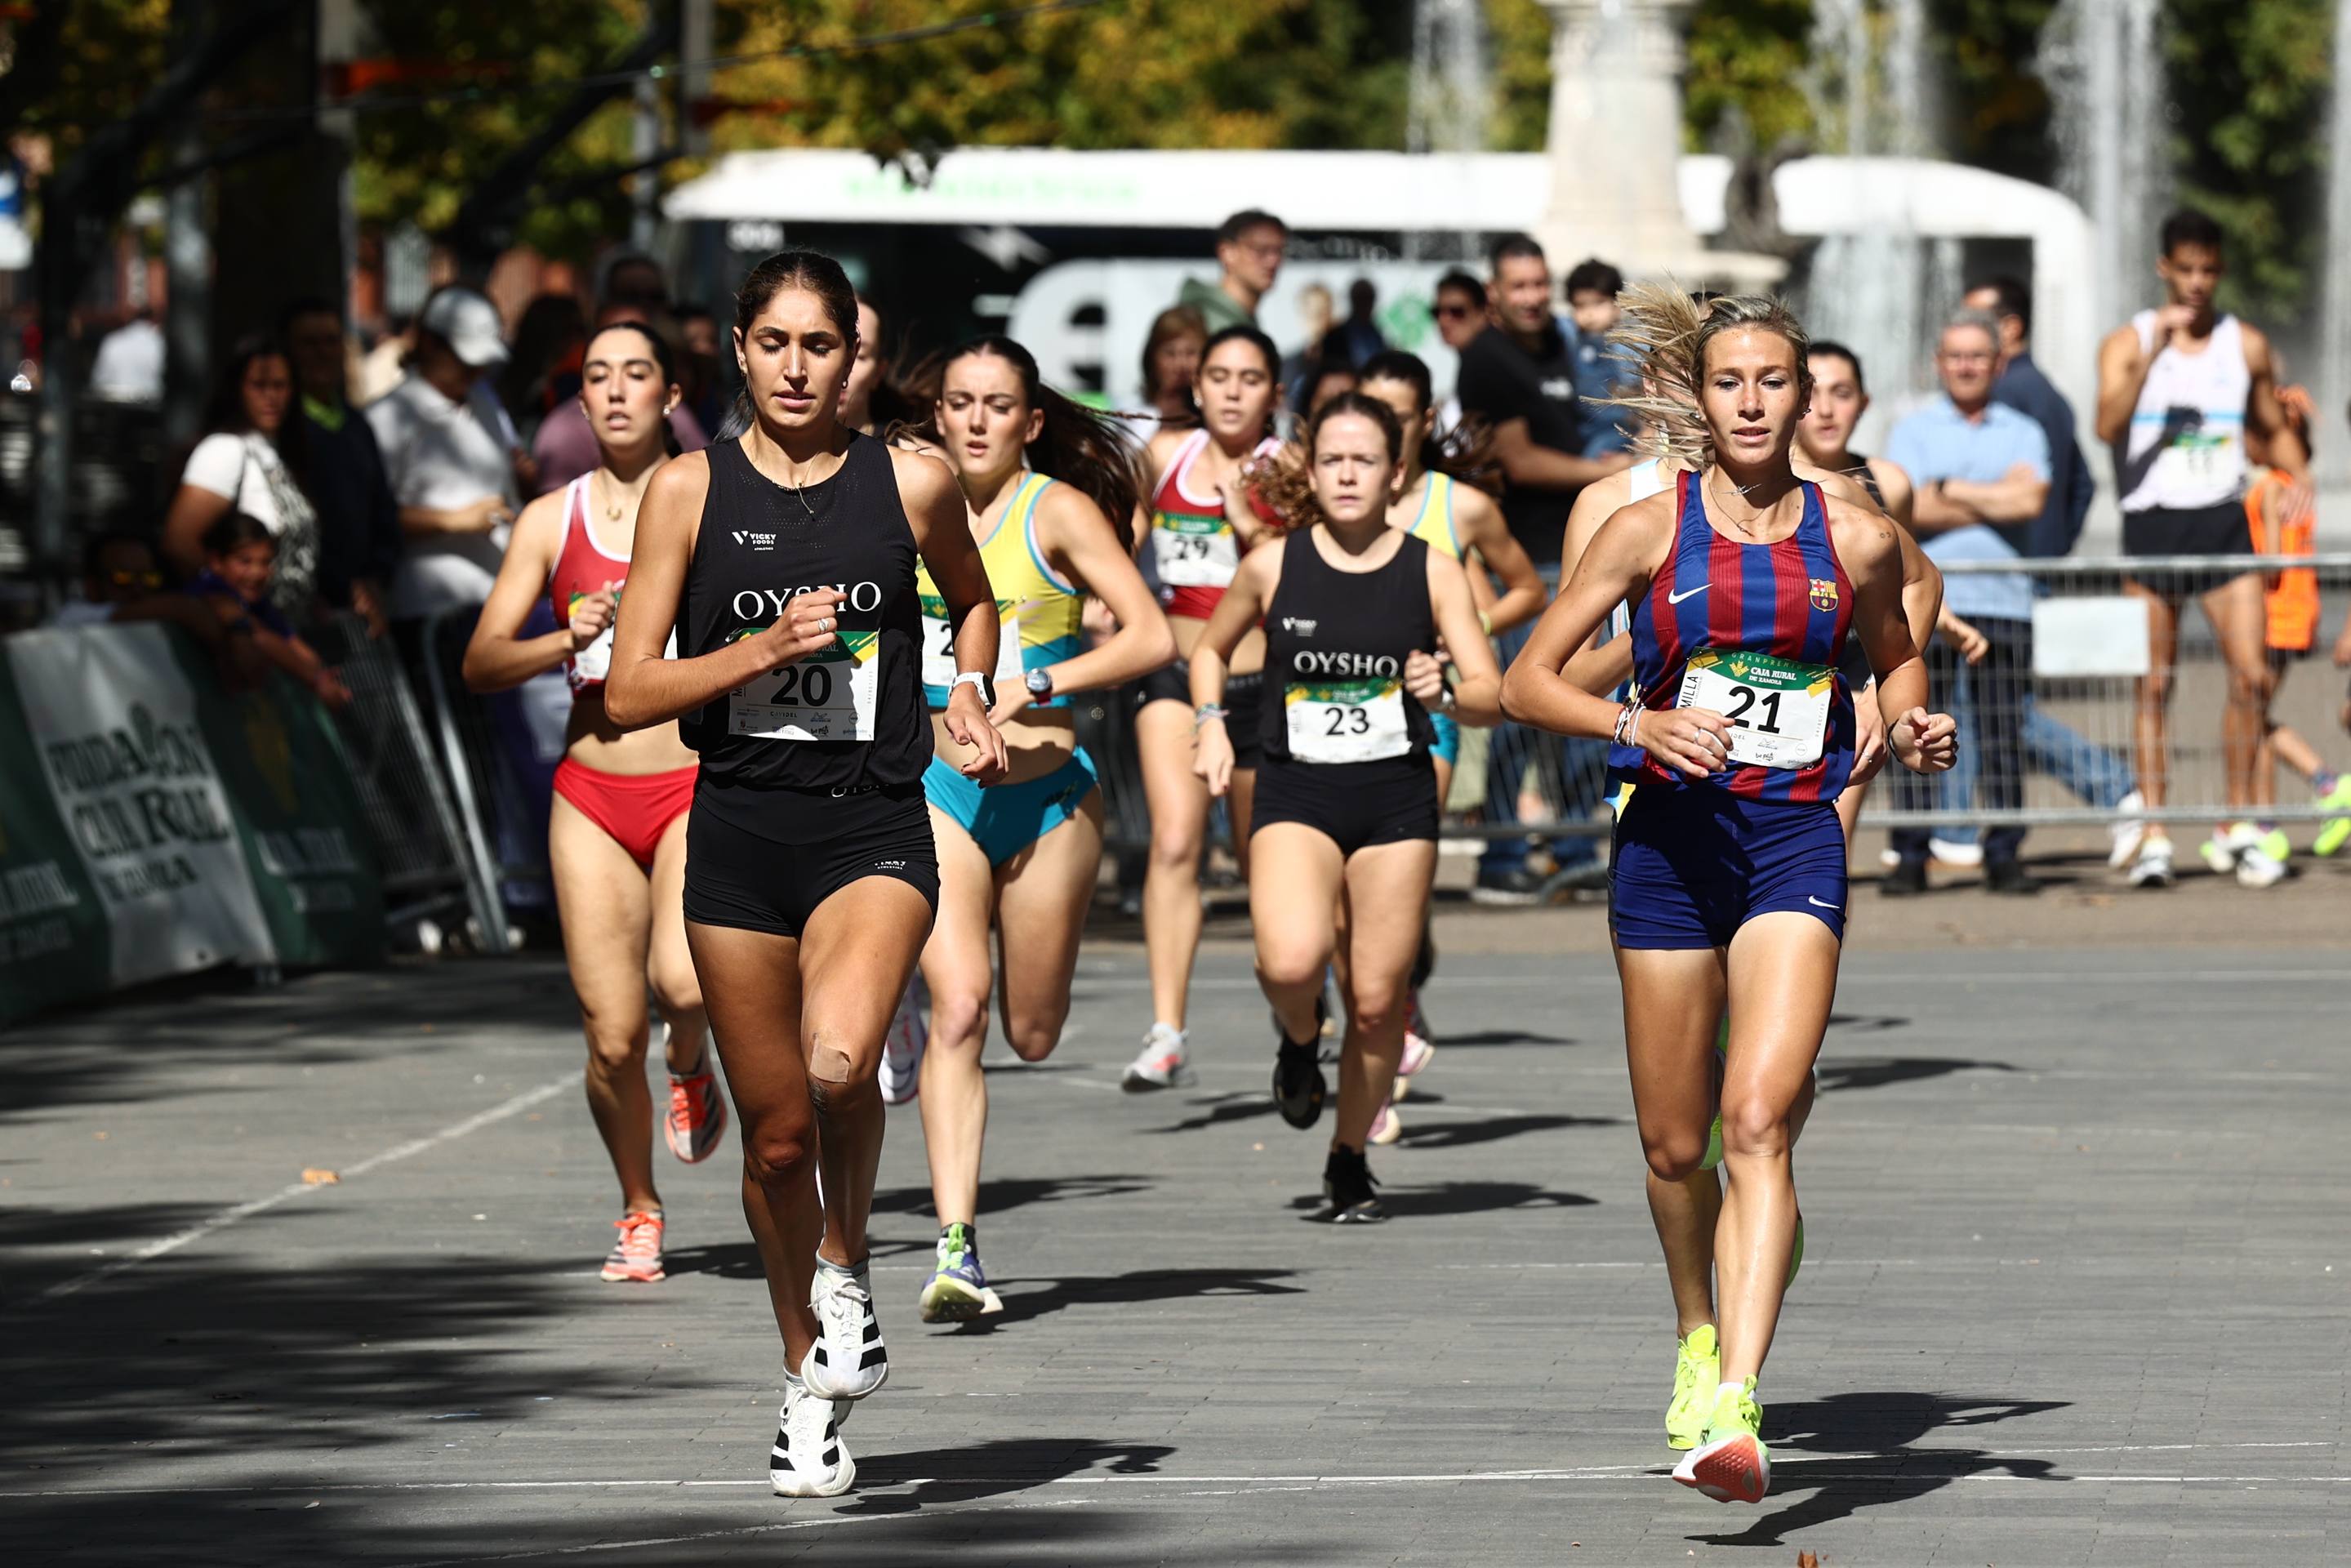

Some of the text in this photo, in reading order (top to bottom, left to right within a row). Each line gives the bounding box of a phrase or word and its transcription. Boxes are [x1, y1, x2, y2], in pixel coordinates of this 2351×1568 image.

[1174, 534, 1209, 559] 29
[939, 624, 955, 657] 2
[1293, 651, 1399, 679] OYSHO
[1751, 667, 1797, 680] CAJA RURAL
[770, 664, 832, 707] 20
[1680, 676, 1699, 708] MILLA
[1758, 677, 1782, 685] ZAMORA
[1325, 707, 1369, 736] 23
[1725, 686, 1782, 734] 21
